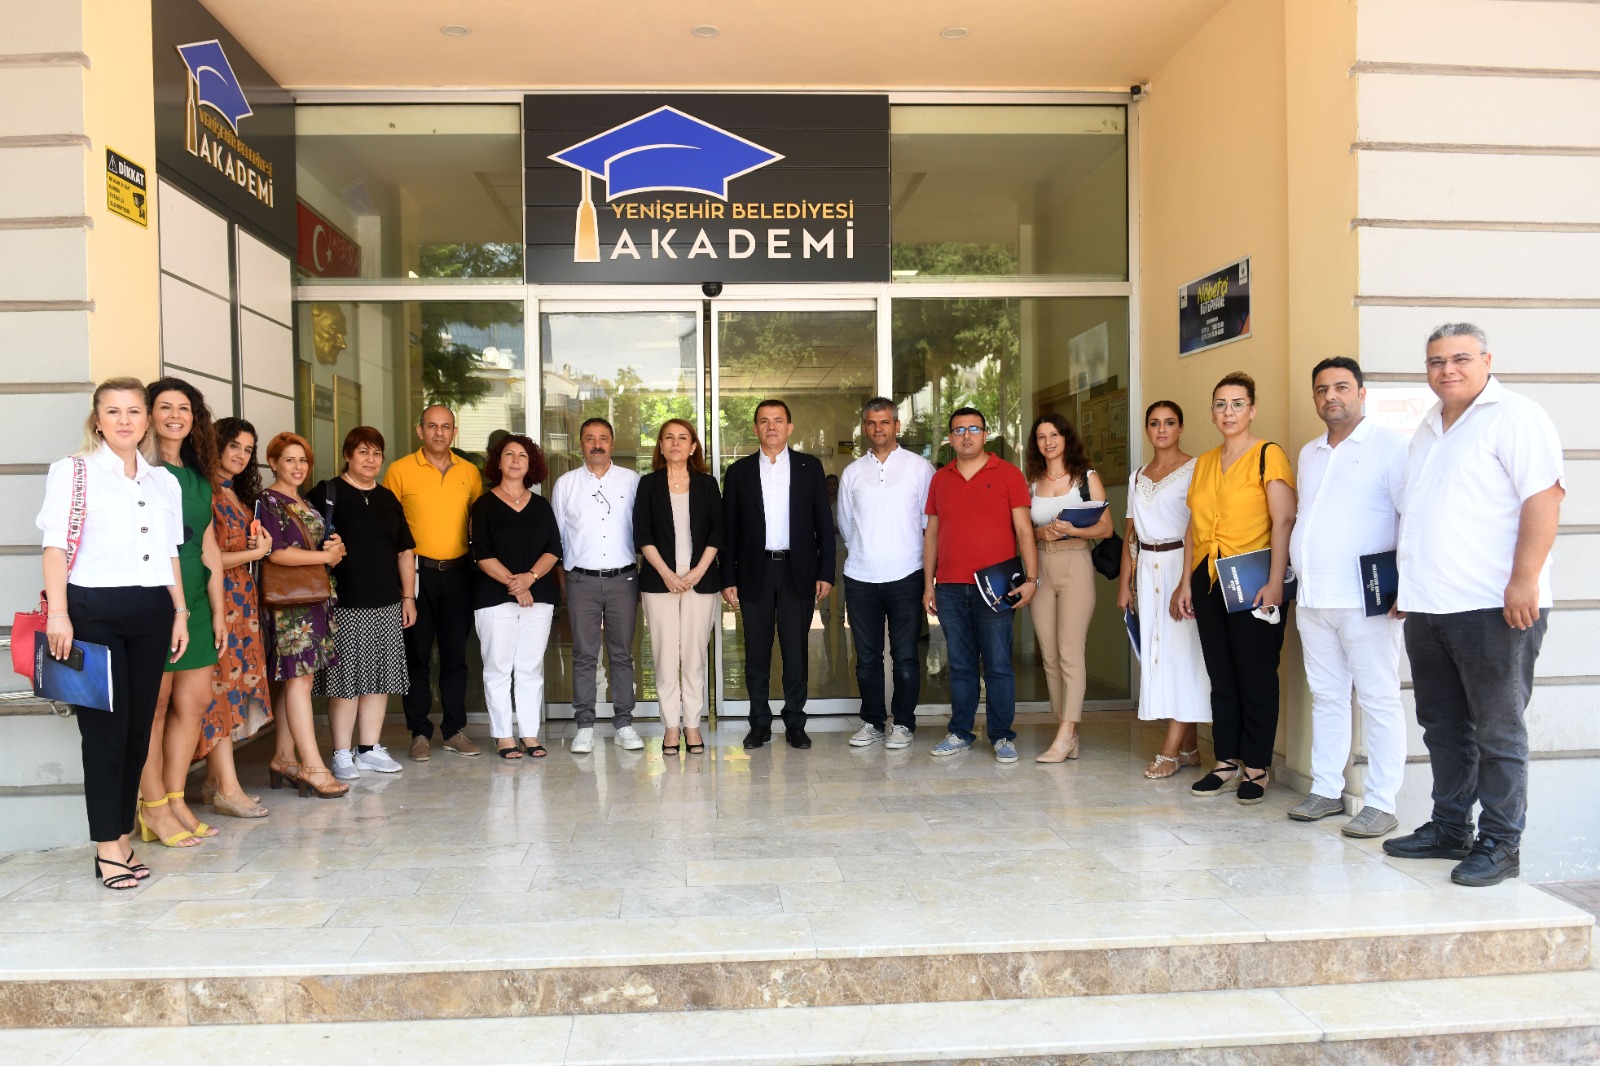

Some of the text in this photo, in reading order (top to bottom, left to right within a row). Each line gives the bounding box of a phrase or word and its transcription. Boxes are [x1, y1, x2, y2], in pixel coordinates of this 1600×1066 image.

[118, 161, 145, 186] DİKKAT
[200, 132, 274, 208] AKADEMİ
[611, 199, 854, 223] YENİŞEHİR BELEDİYESİ
[610, 220, 854, 260] AKADEMİ
[1197, 276, 1229, 305] Nöbetçi
